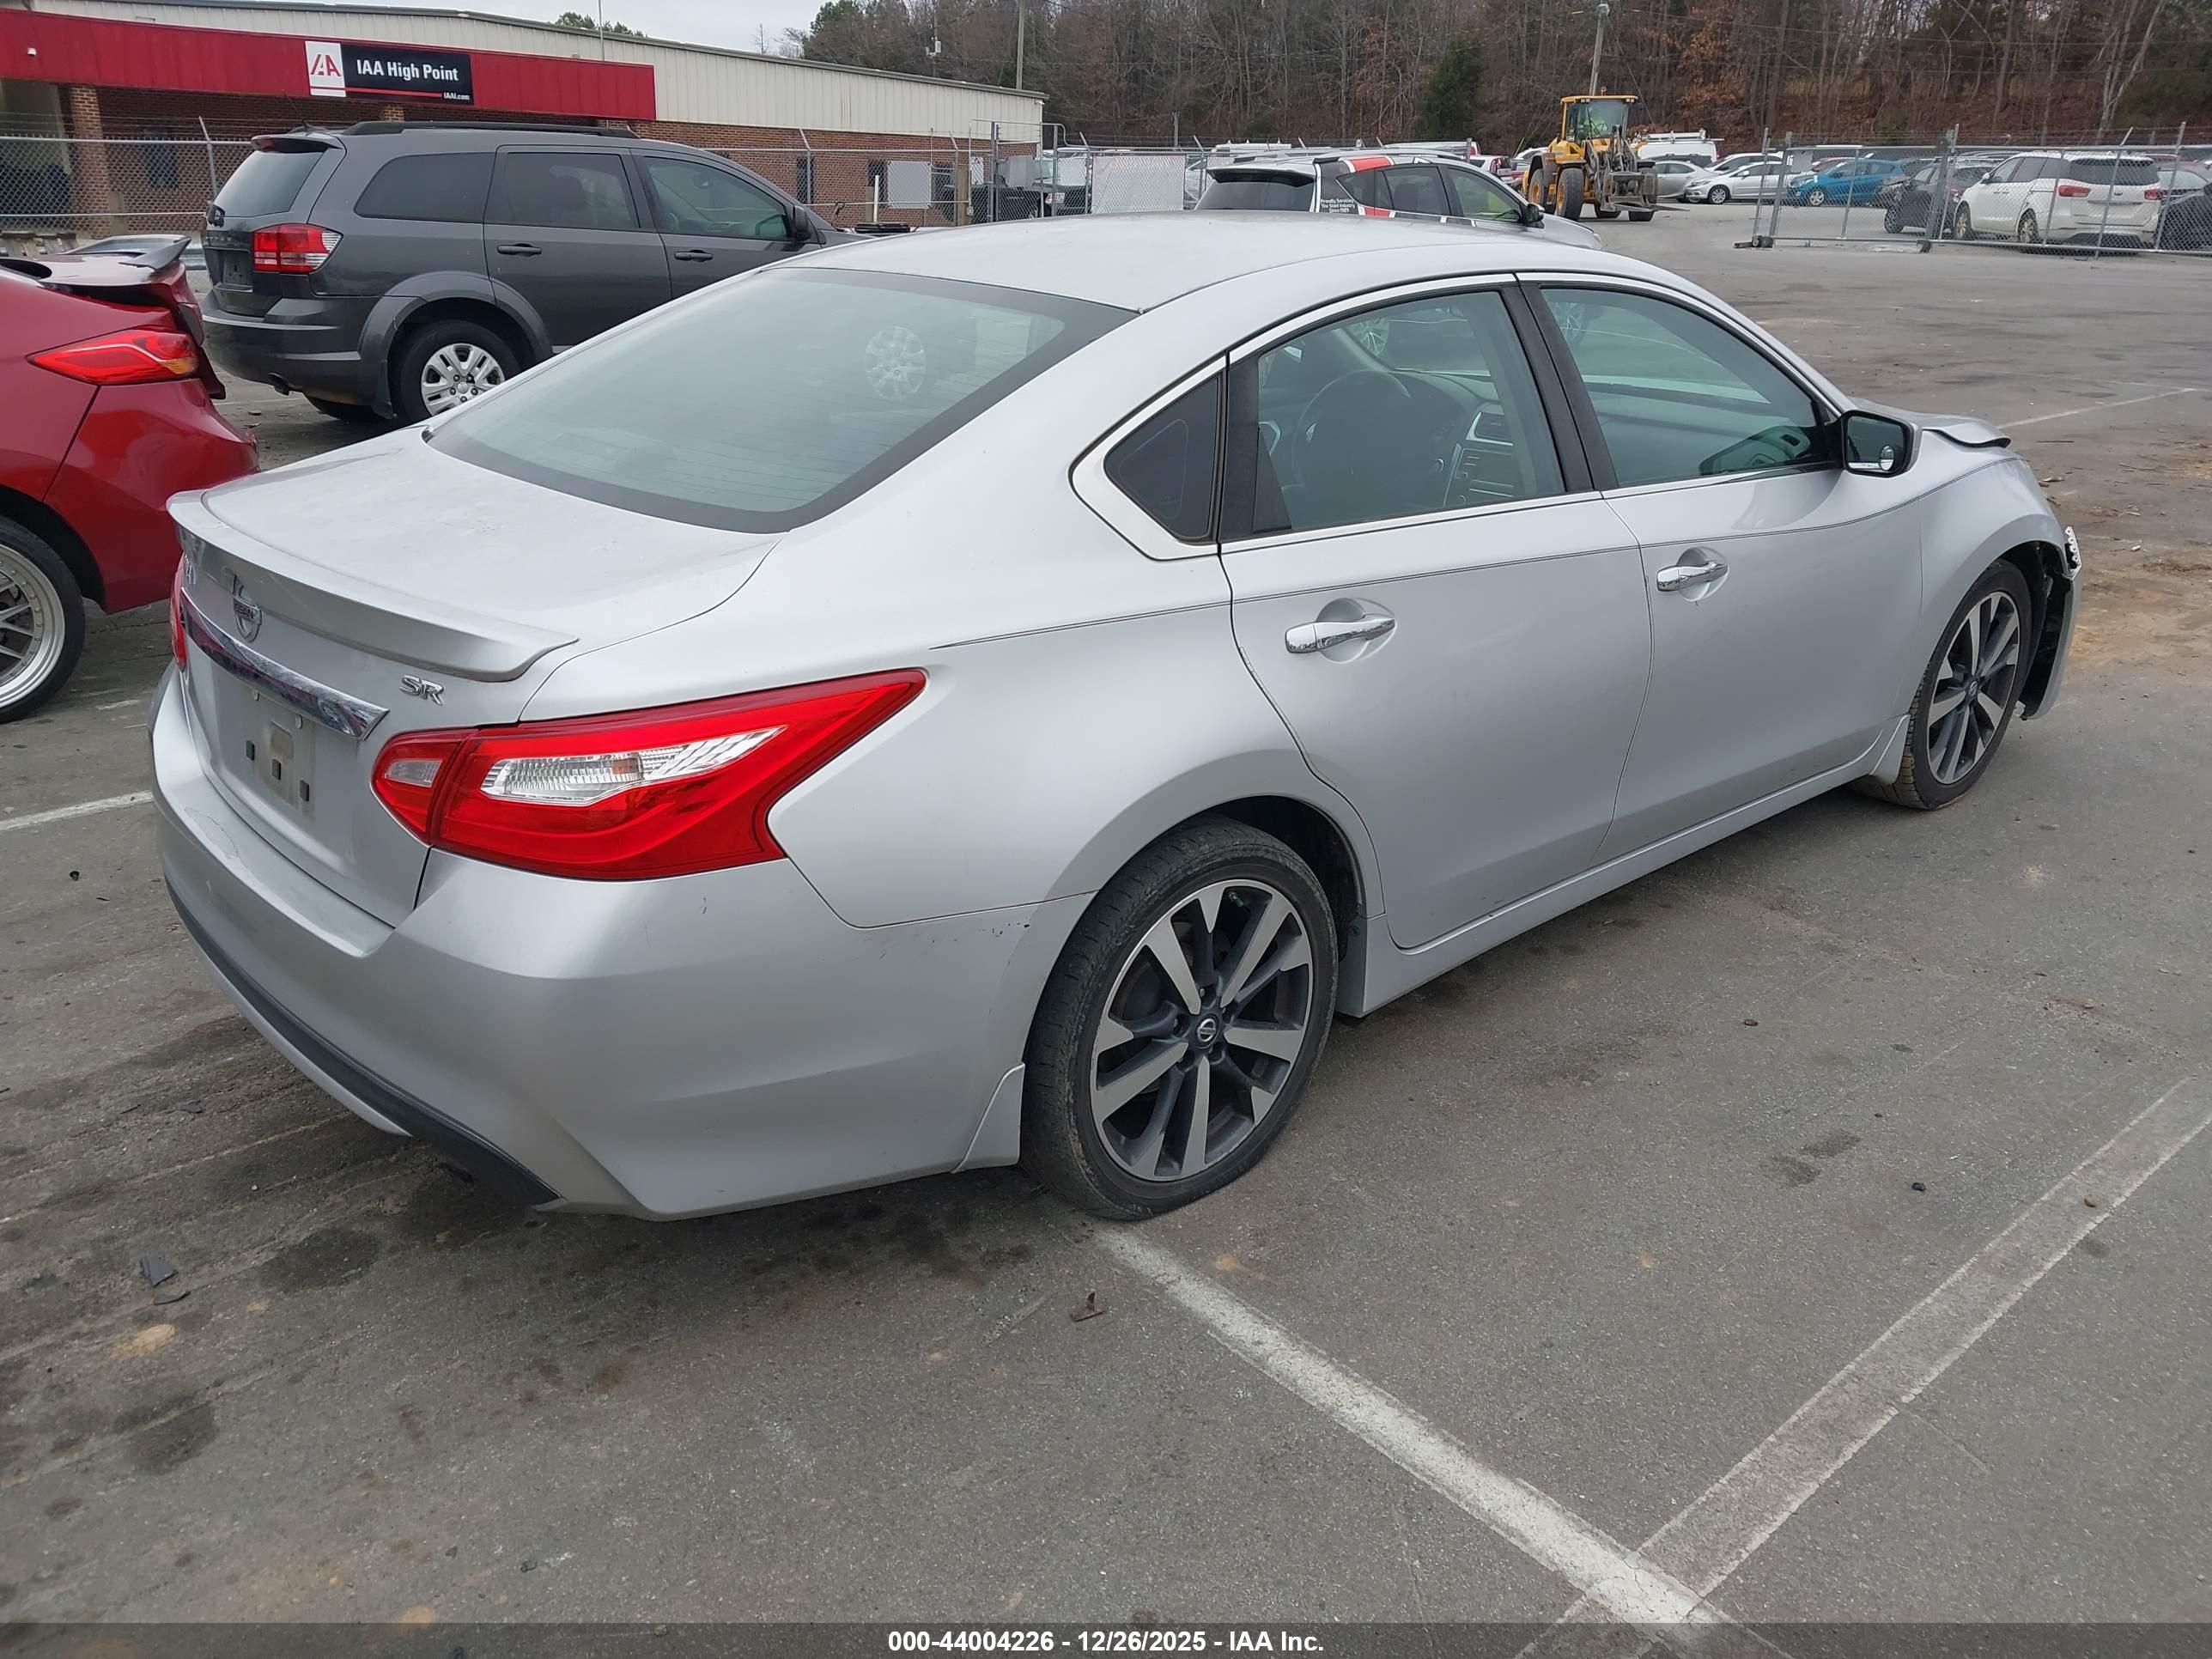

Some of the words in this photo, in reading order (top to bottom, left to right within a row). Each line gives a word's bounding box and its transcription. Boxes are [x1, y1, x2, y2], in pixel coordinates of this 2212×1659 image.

[356, 59, 384, 76] IAA
[386, 61, 420, 81] High
[422, 64, 459, 81] Point
[399, 673, 444, 706] SR
